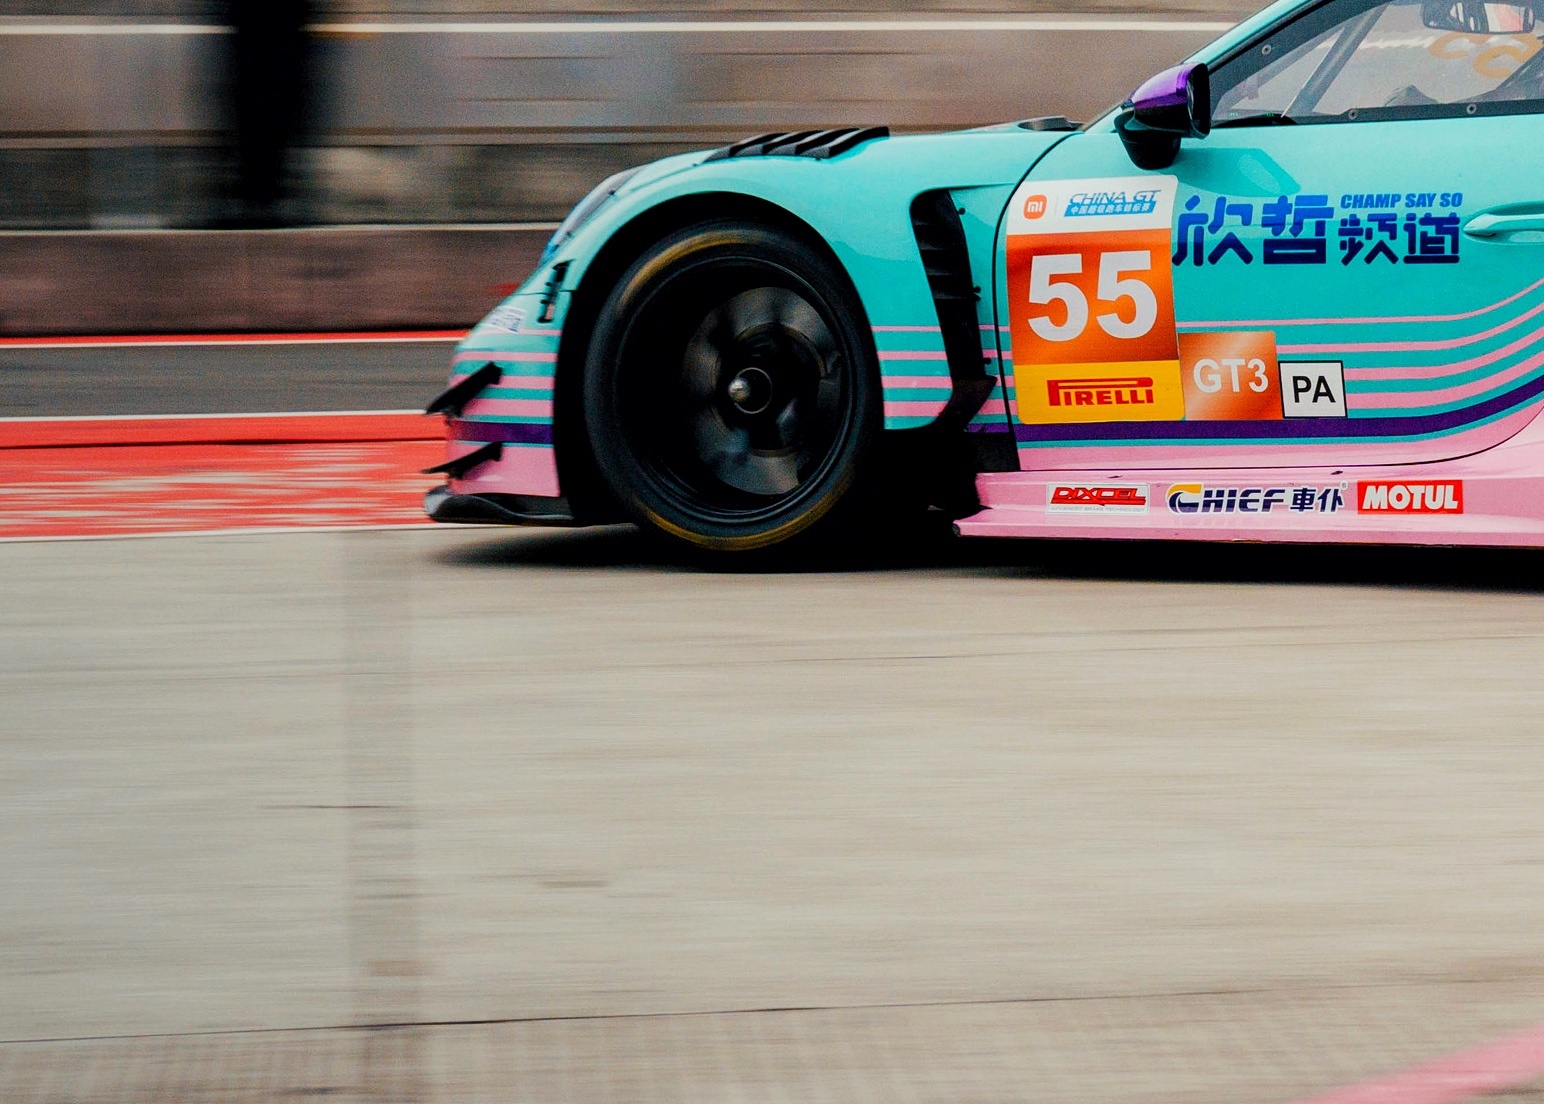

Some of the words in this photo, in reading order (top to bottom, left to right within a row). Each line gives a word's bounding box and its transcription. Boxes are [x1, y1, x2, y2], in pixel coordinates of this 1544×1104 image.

[1069, 191, 1126, 205] CHINA
[1132, 189, 1162, 203] GT
[1340, 194, 1401, 209] CHAMP
[1404, 194, 1437, 208] SAY
[1439, 192, 1464, 208] SO
[1171, 194, 1461, 267] 欣哲频道
[1027, 250, 1158, 342] 55
[1193, 358, 1269, 394] GT3
[1293, 375, 1336, 404] PA
[1047, 377, 1154, 406] PIRELLI
[1051, 487, 1147, 506] DIXCEL
[1362, 484, 1459, 511] MOTUL
